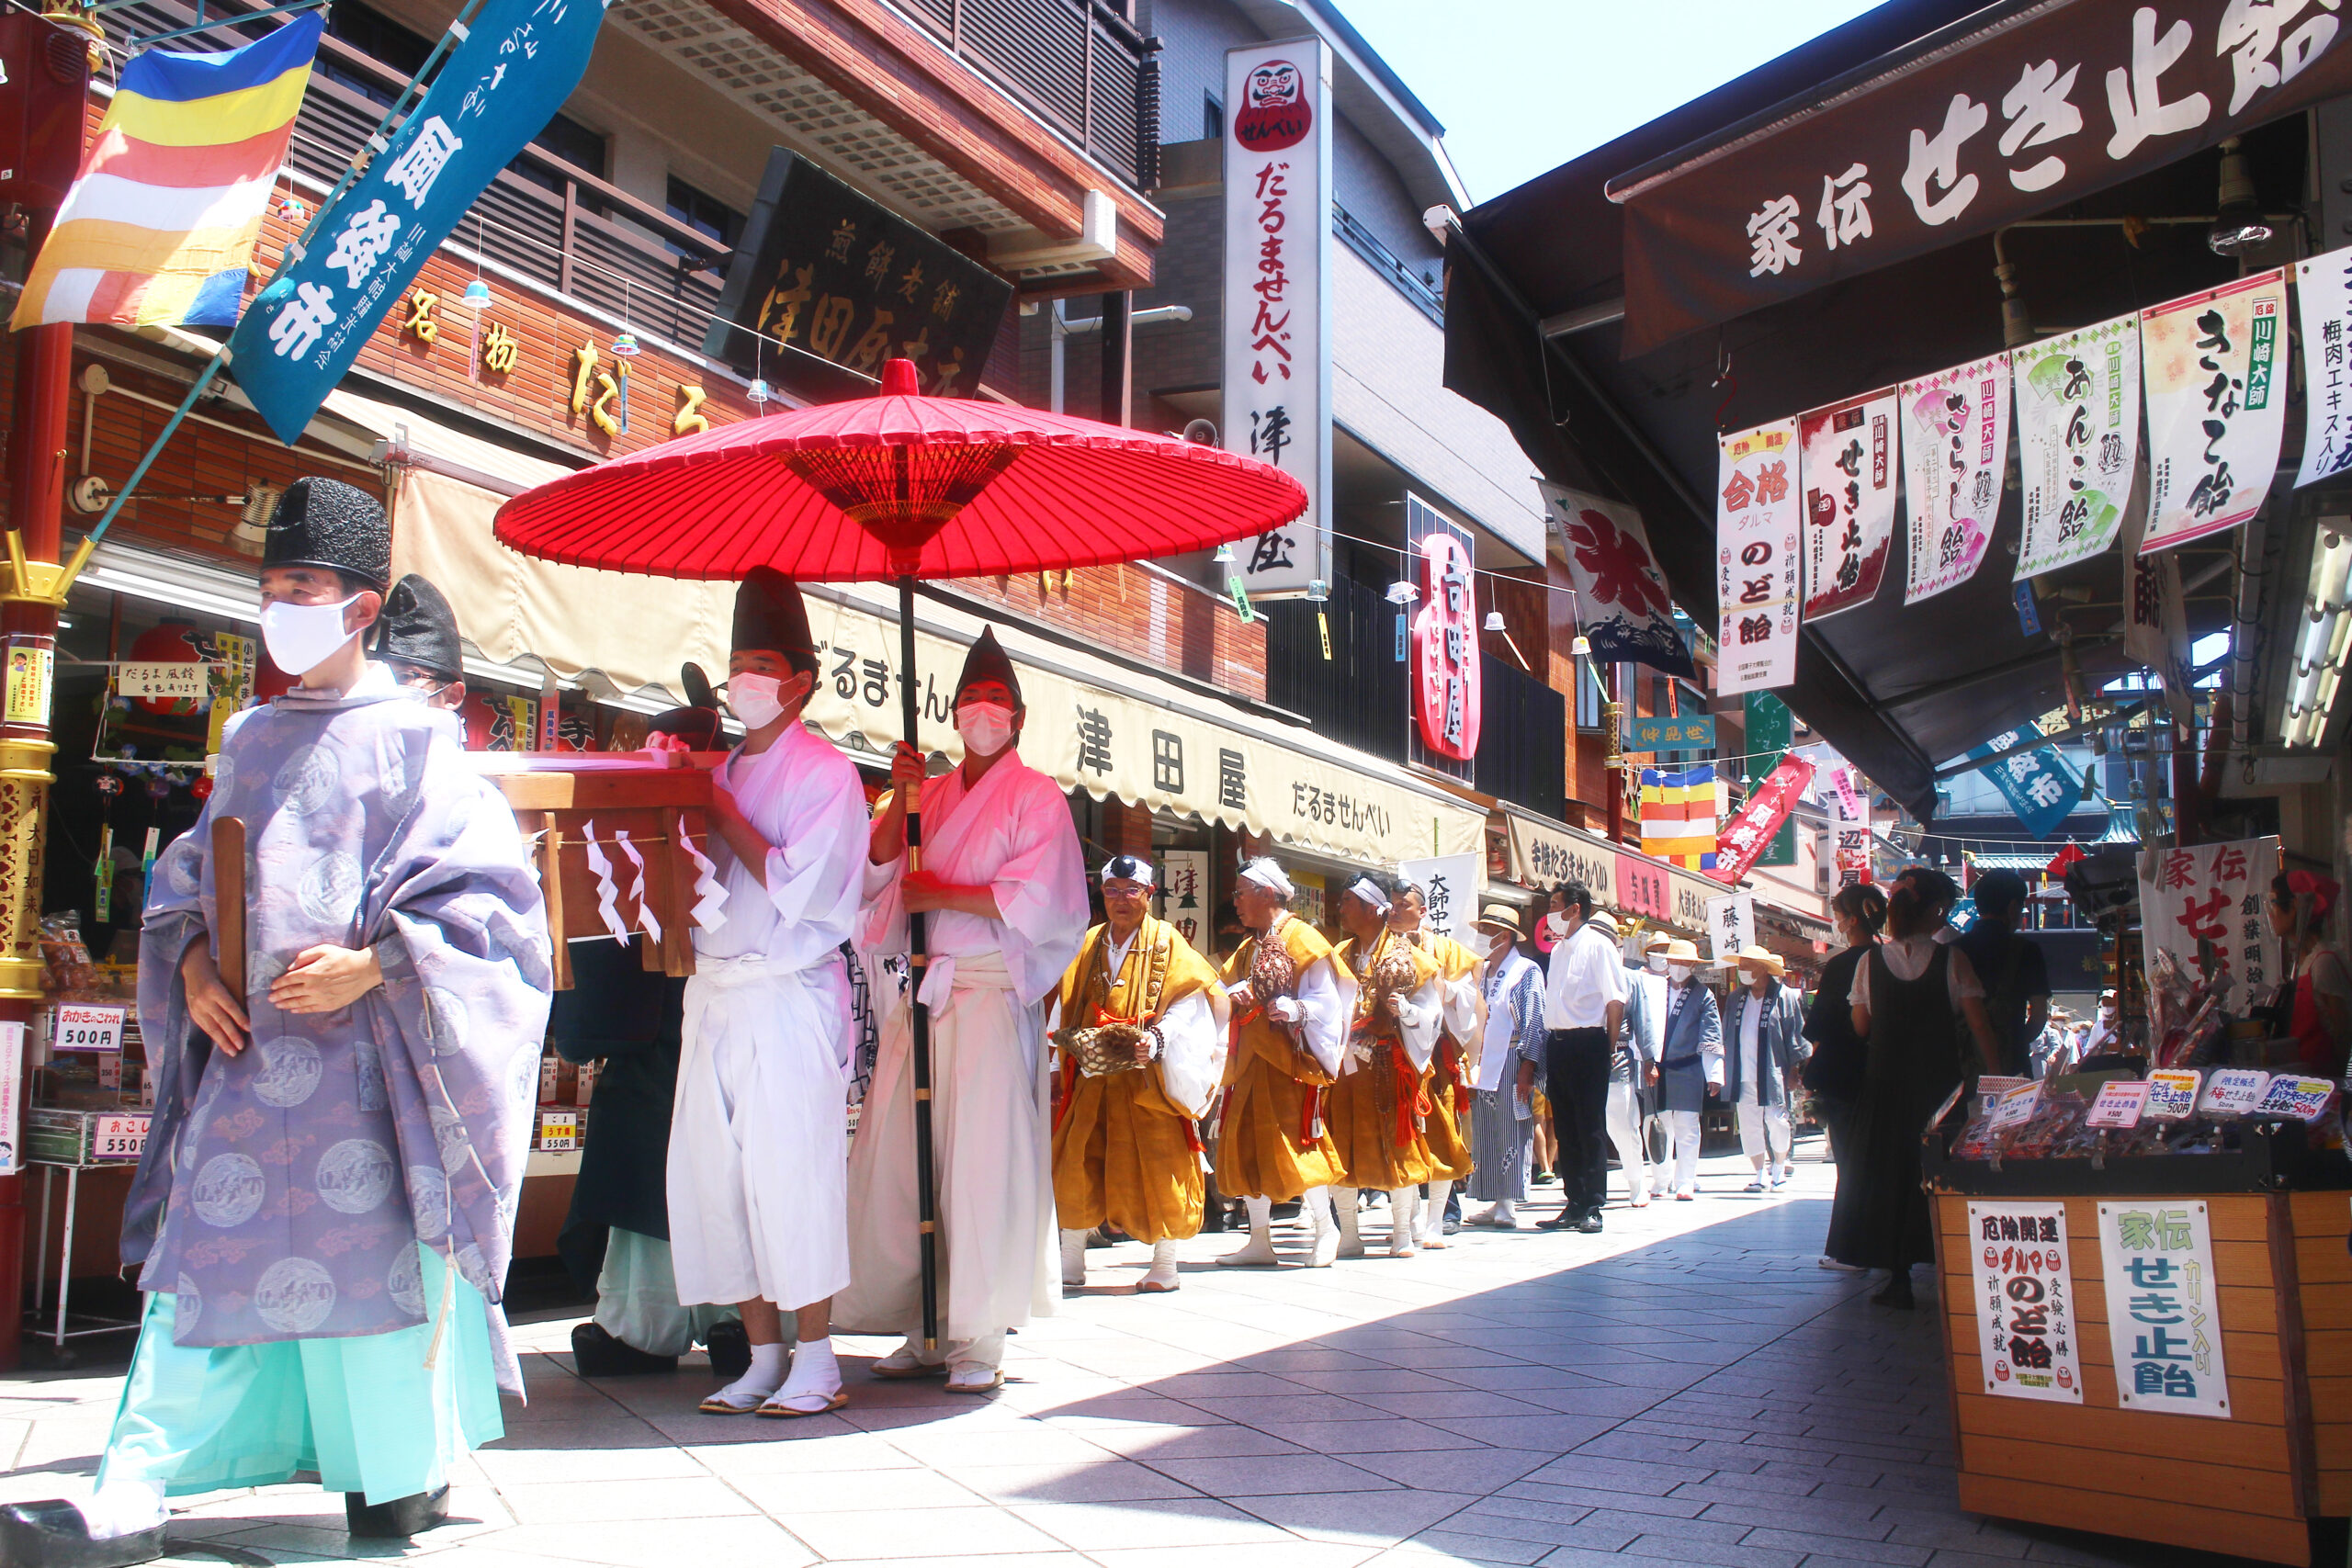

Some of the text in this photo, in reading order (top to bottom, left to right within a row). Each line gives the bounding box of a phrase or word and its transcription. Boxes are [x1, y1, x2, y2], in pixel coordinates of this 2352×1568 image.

[1240, 120, 1304, 141] せんべい
[405, 287, 518, 375] 名物
[1247, 162, 1294, 575] だるませんべい 津屋
[2107, 355, 2121, 427] 川崎大師
[2248, 319, 2273, 408] 川崎大師
[1981, 379, 1995, 465] 川崎大師
[2185, 309, 2245, 519] きなこ飴
[2315, 319, 2344, 476] 梅肉エキス入り
[1873, 425, 1885, 484] 川崎大師
[2057, 354, 2095, 546] あんこ飴
[1722, 458, 1789, 513] 合格
[1939, 392, 1968, 572] さらし飴
[1737, 511, 1774, 532] ダルマ
[1835, 438, 1864, 592] せき止飴
[1738, 540, 1774, 646] のど飴
[1781, 553, 1796, 616] 祈願成就
[812, 639, 949, 724] るまん
[1076, 703, 1247, 812] 津田屋
[1641, 725, 1706, 741] 仲見世
[1291, 778, 1392, 839] だるませんべい
[1722, 905, 1741, 953] 藤崎
[62, 1010, 121, 1025] おかきのこわれ
[65, 1029, 113, 1045] 500円
[2150, 1090, 2193, 1103] せき止飴
[2166, 1102, 2190, 1114] 500円
[2208, 1087, 2256, 1102] 梅せき止飴
[2221, 1076, 2256, 1088] 限定販売
[2290, 1102, 2317, 1116] 500円
[547, 1139, 571, 1148] 550円
[1981, 1215, 2060, 1244] 厄除開運
[2001, 1246, 2043, 1275] ダルマ
[2118, 1210, 2194, 1251] 家伝
[1987, 1276, 2007, 1353] 祈願成就
[2006, 1275, 2053, 1370] のど飴
[2049, 1278, 2069, 1358] 受験必勝
[2122, 1257, 2198, 1399] せき止飴
[2183, 1259, 2211, 1376] カリン入り
